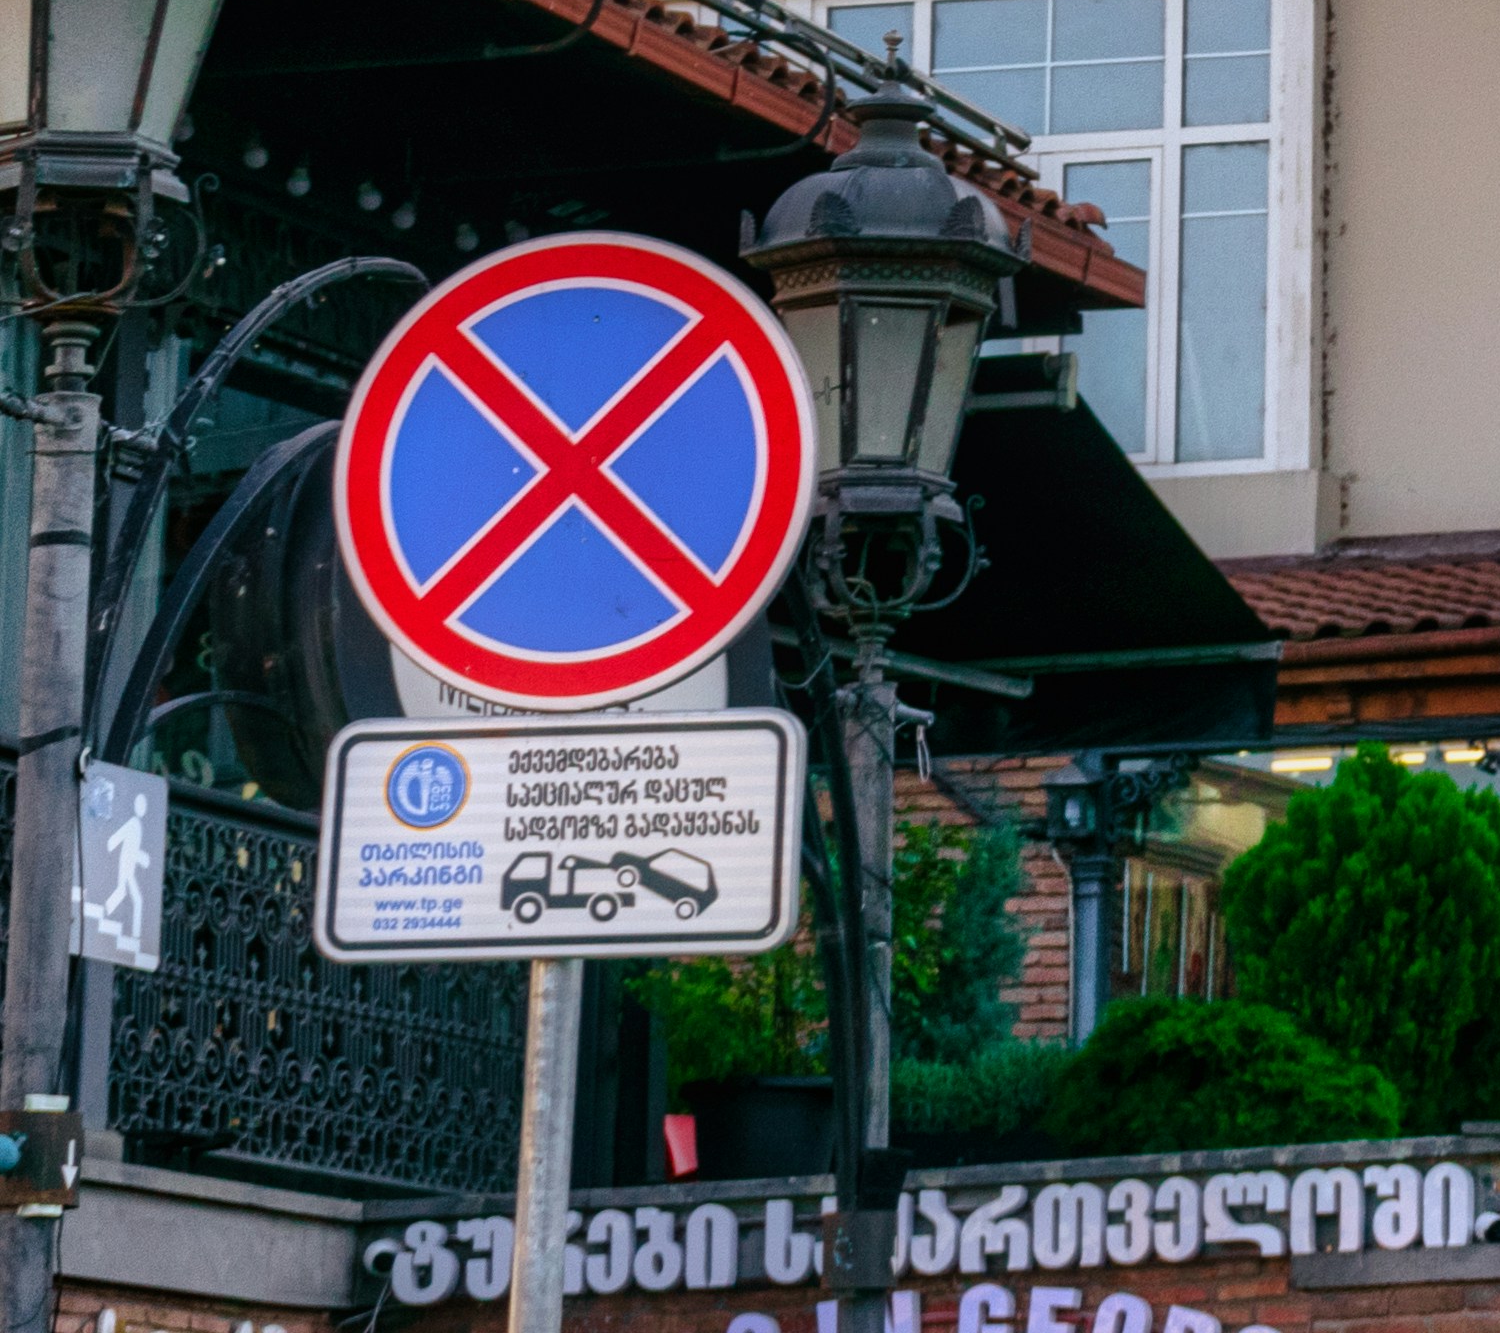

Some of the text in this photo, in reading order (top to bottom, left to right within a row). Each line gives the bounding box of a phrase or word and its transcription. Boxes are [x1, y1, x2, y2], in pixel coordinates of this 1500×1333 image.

[508, 744, 680, 774] ექვემდებარება
[506, 776, 727, 808] სპეციალურ დაცულ
[503, 809, 761, 841] სადგომზე გადაყვანას
[360, 841, 485, 862] თბილისის
[358, 864, 483, 887] პარკინგი
[374, 897, 463, 913] www.tp.ge
[372, 916, 462, 931] 032 2934444
[764, 1161, 1476, 1286] სართველოში
